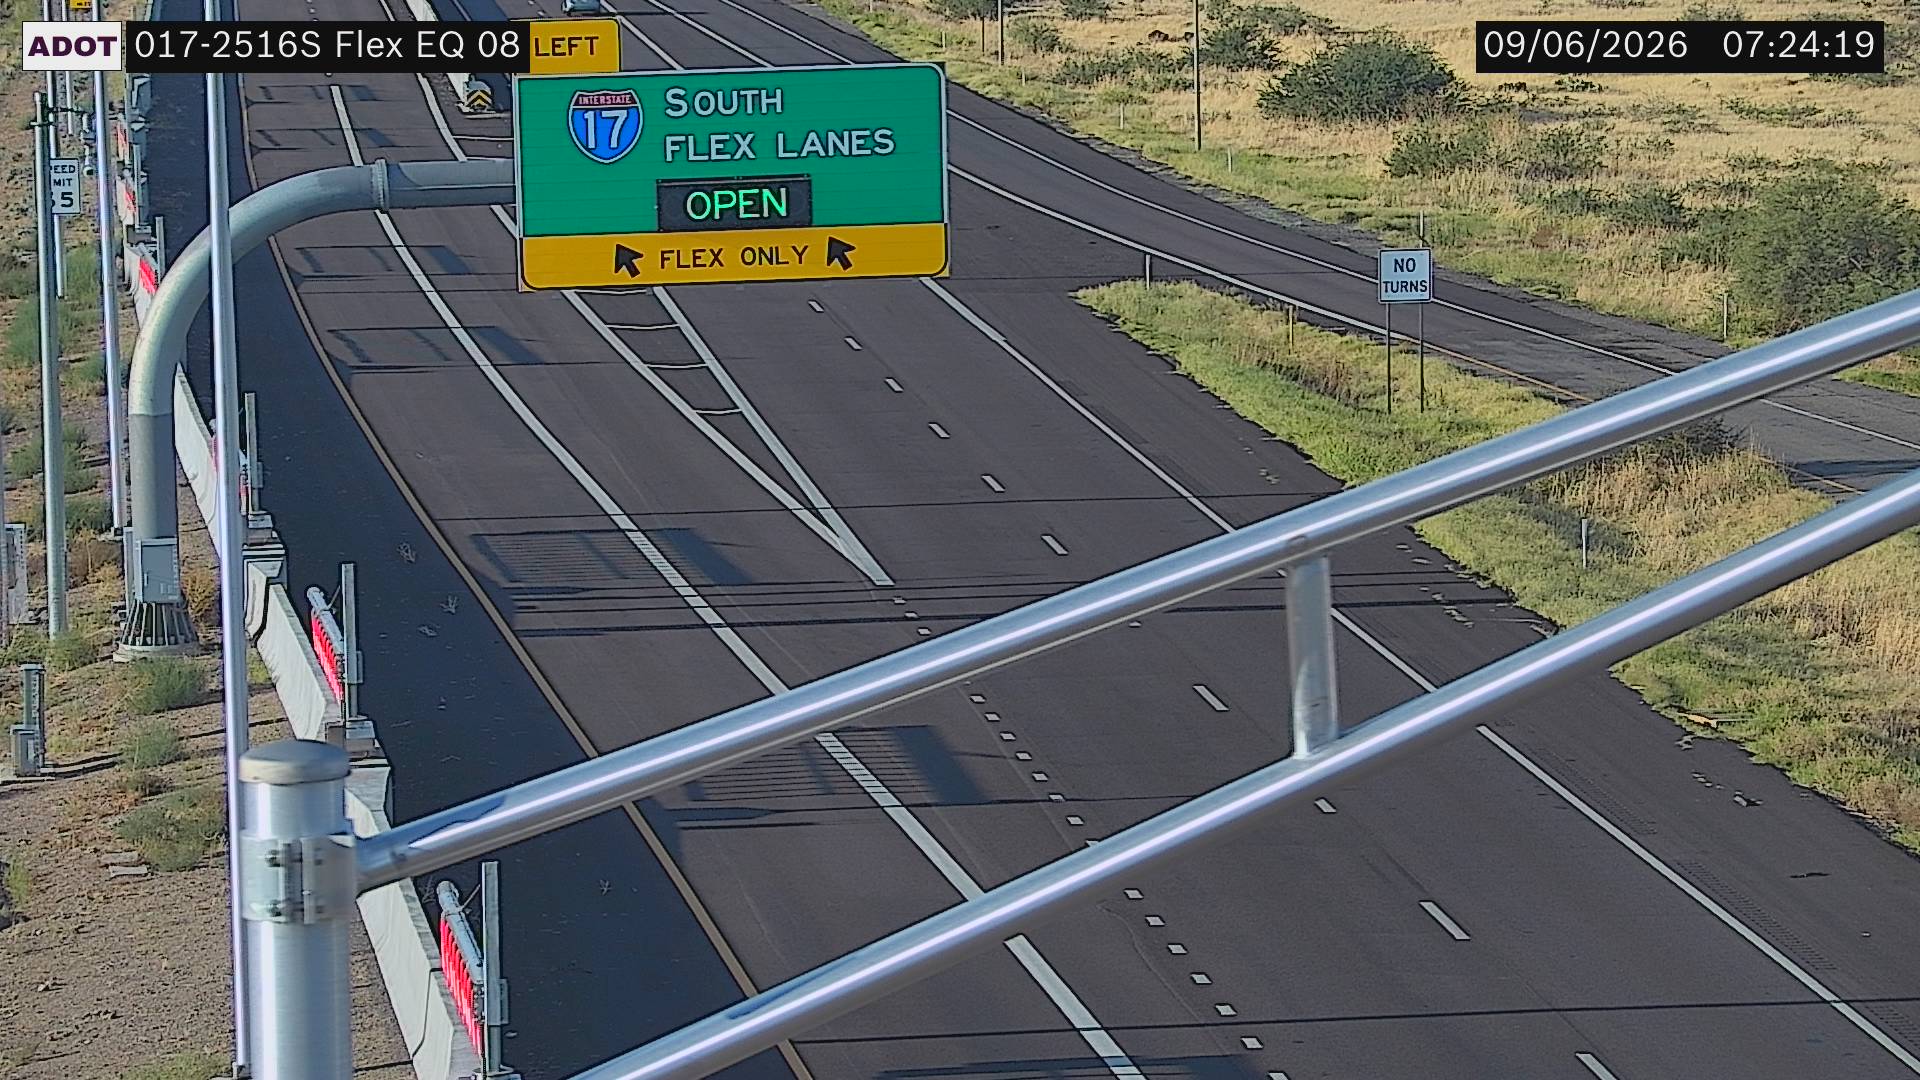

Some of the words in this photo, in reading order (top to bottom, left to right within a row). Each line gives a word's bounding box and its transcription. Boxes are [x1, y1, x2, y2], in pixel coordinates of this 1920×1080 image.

[534, 36, 599, 57] LEFT
[579, 94, 632, 105] INTERSTATE
[665, 88, 783, 117] SOUTH
[584, 110, 628, 149] 17
[665, 133, 756, 162] FLEX
[777, 129, 896, 158] LANES
[51, 165, 75, 173] EED
[53, 178, 72, 186] MIT
[686, 187, 787, 220] OPEN
[660, 248, 724, 269] FLEX
[740, 245, 809, 266] ONLY
[1393, 257, 1416, 273] NO
[1382, 280, 1428, 293] TURNS
